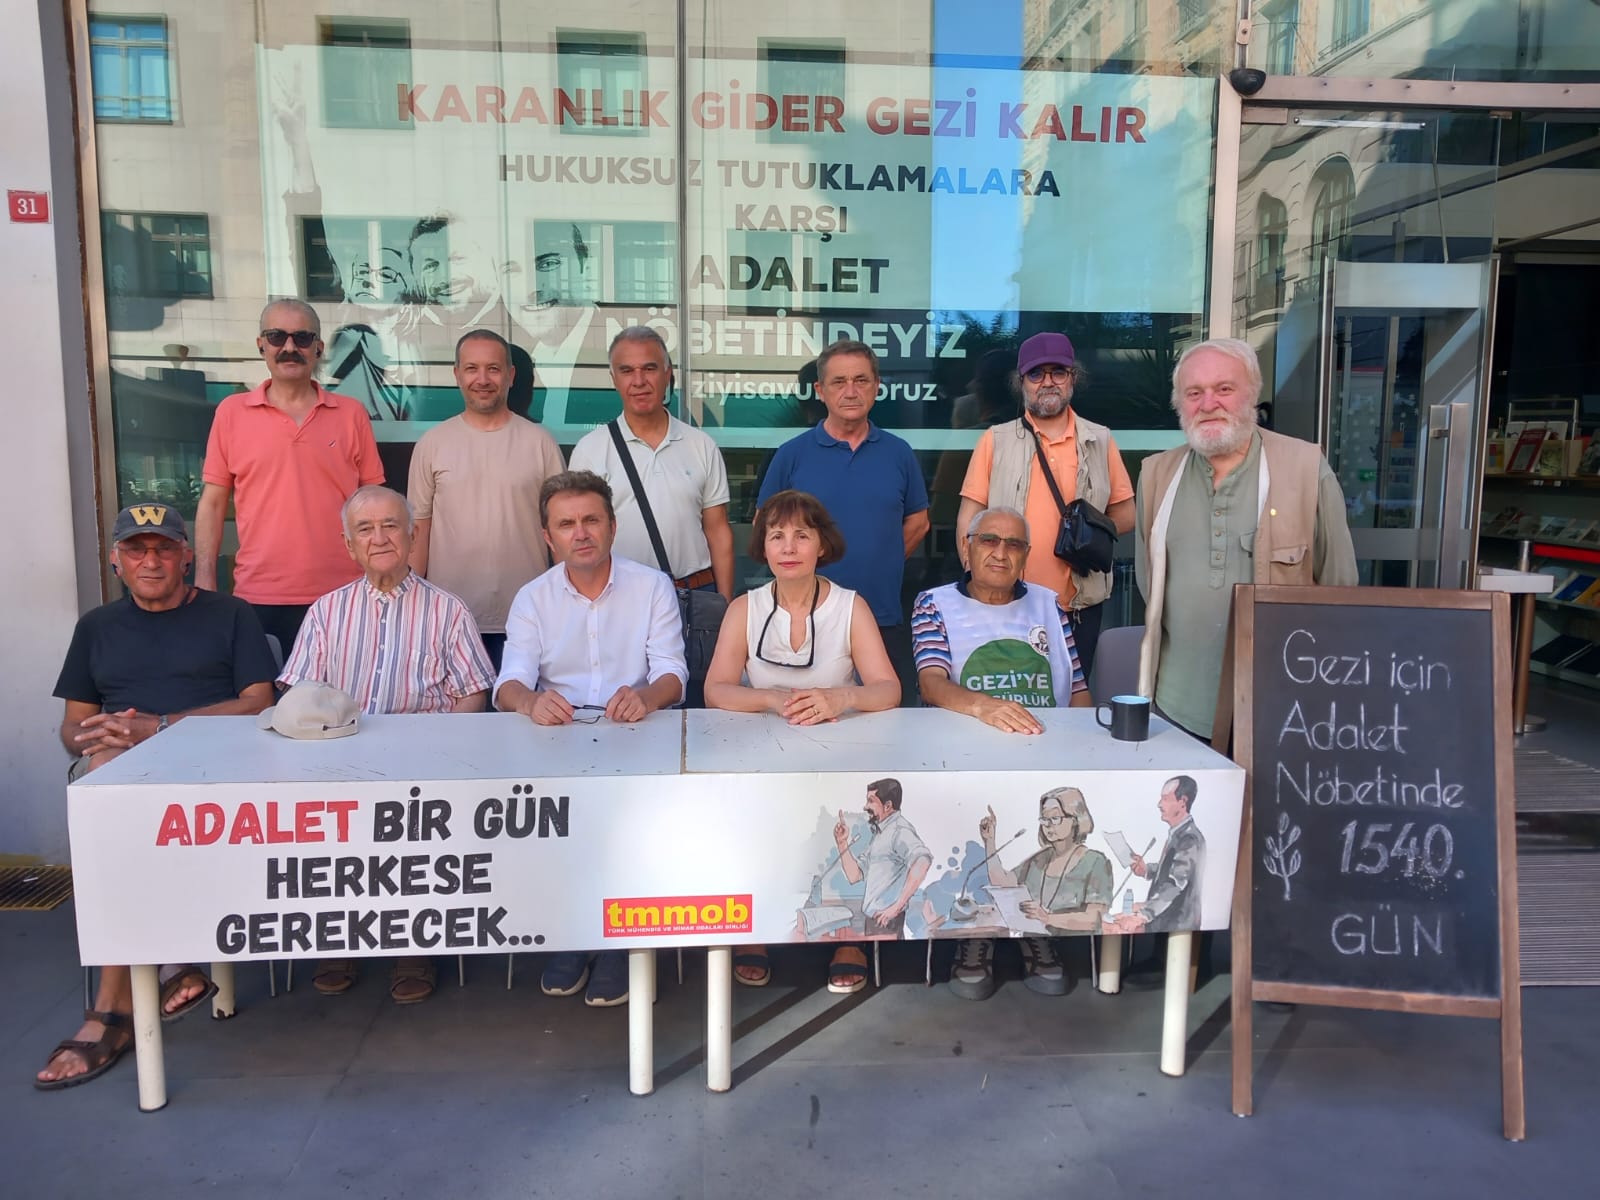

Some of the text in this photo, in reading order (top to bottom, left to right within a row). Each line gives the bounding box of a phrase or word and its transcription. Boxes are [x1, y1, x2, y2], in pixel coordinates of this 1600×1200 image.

[396, 79, 1147, 144] KARANLIK GİDER GEZİ KALIR
[500, 154, 1061, 197] HUKUKSUZ TUTUKLAMALARA
[17, 198, 38, 215] 31
[735, 203, 848, 242] KARŞI
[689, 255, 890, 293] ADALET
[128, 505, 168, 526] W
[1283, 629, 1451, 695] Gezi için
[1278, 700, 1409, 754] Adalet
[1276, 761, 1465, 808] Nöbetinde
[155, 783, 570, 846] ADALET BİR GÜN
[1339, 819, 1465, 880] 1540.
[266, 852, 493, 899] HERKESE
[215, 906, 546, 955] GEREKECEK...
[607, 897, 748, 927] tmmob
[1331, 904, 1443, 956] GÜN
